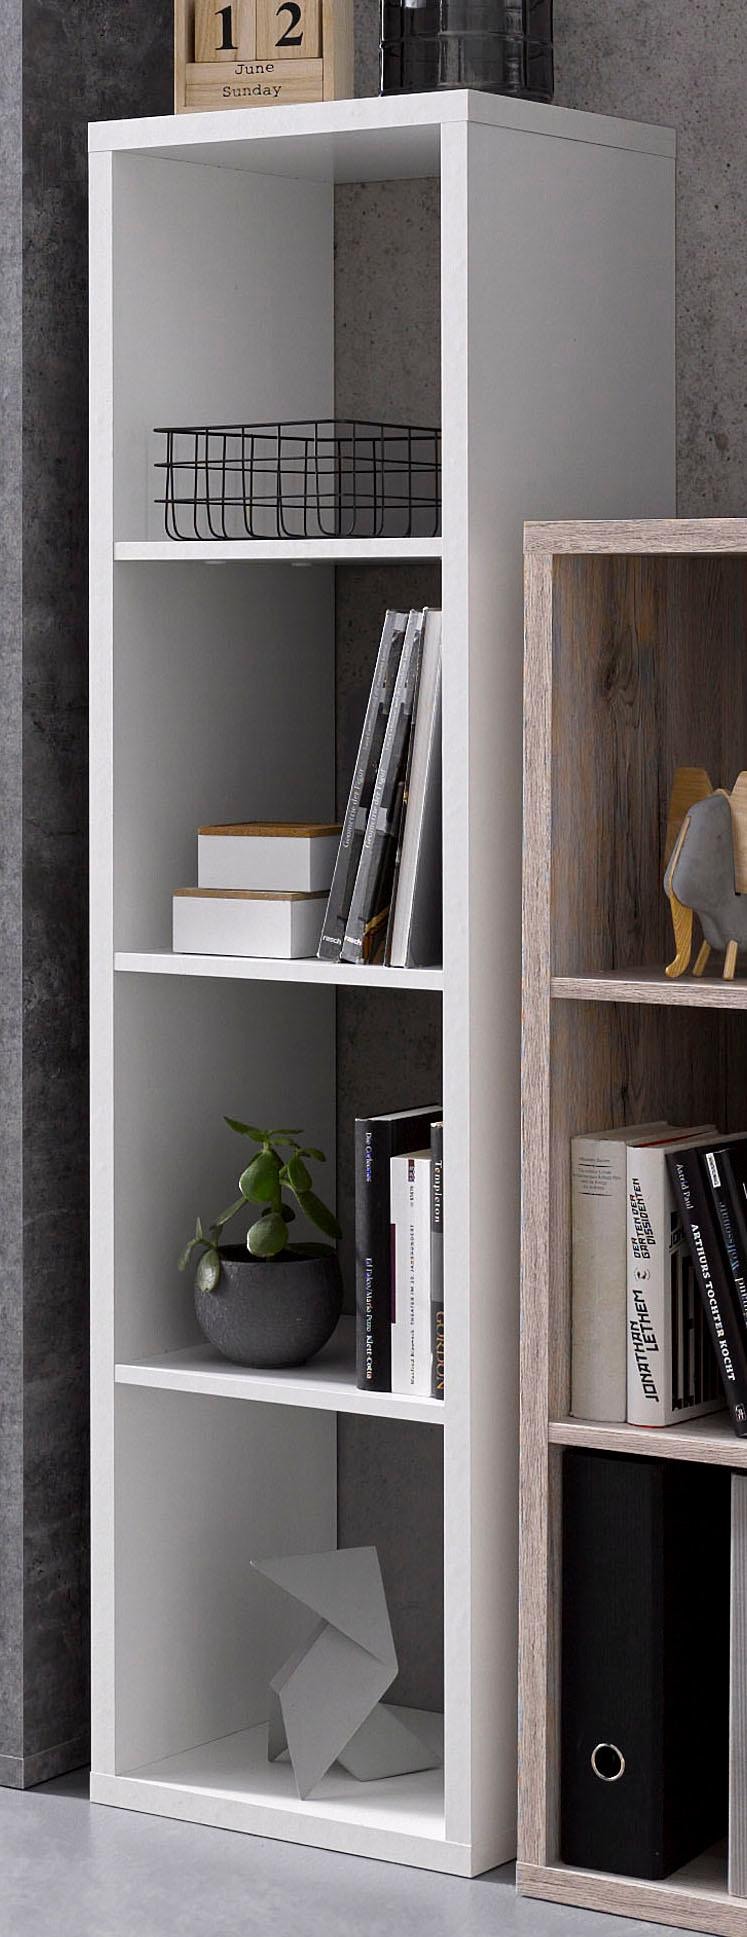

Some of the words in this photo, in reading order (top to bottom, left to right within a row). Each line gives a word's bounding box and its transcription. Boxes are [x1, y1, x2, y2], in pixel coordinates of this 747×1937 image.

[214, 5, 239, 51] 1
[274, 2, 304, 47] 2
[222, 83, 282, 98] Sunday
[234, 63, 275, 75] June
[432, 1160, 443, 1223] Templeton
[629, 1194, 639, 1215] DER
[676, 1164, 689, 1190] Astrid
[683, 1191, 695, 1210] Paul
[632, 1178, 657, 1245] DISSIDENTEN
[631, 1237, 642, 1259] DER
[633, 1216, 651, 1259] GARTEN
[632, 1289, 660, 1351] LETHEM
[691, 1223, 711, 1279] ARTHURS
[705, 1280, 725, 1338] TOCHTER
[719, 1340, 736, 1381] KOCHT
[629, 1320, 660, 1402] JONATHAN
